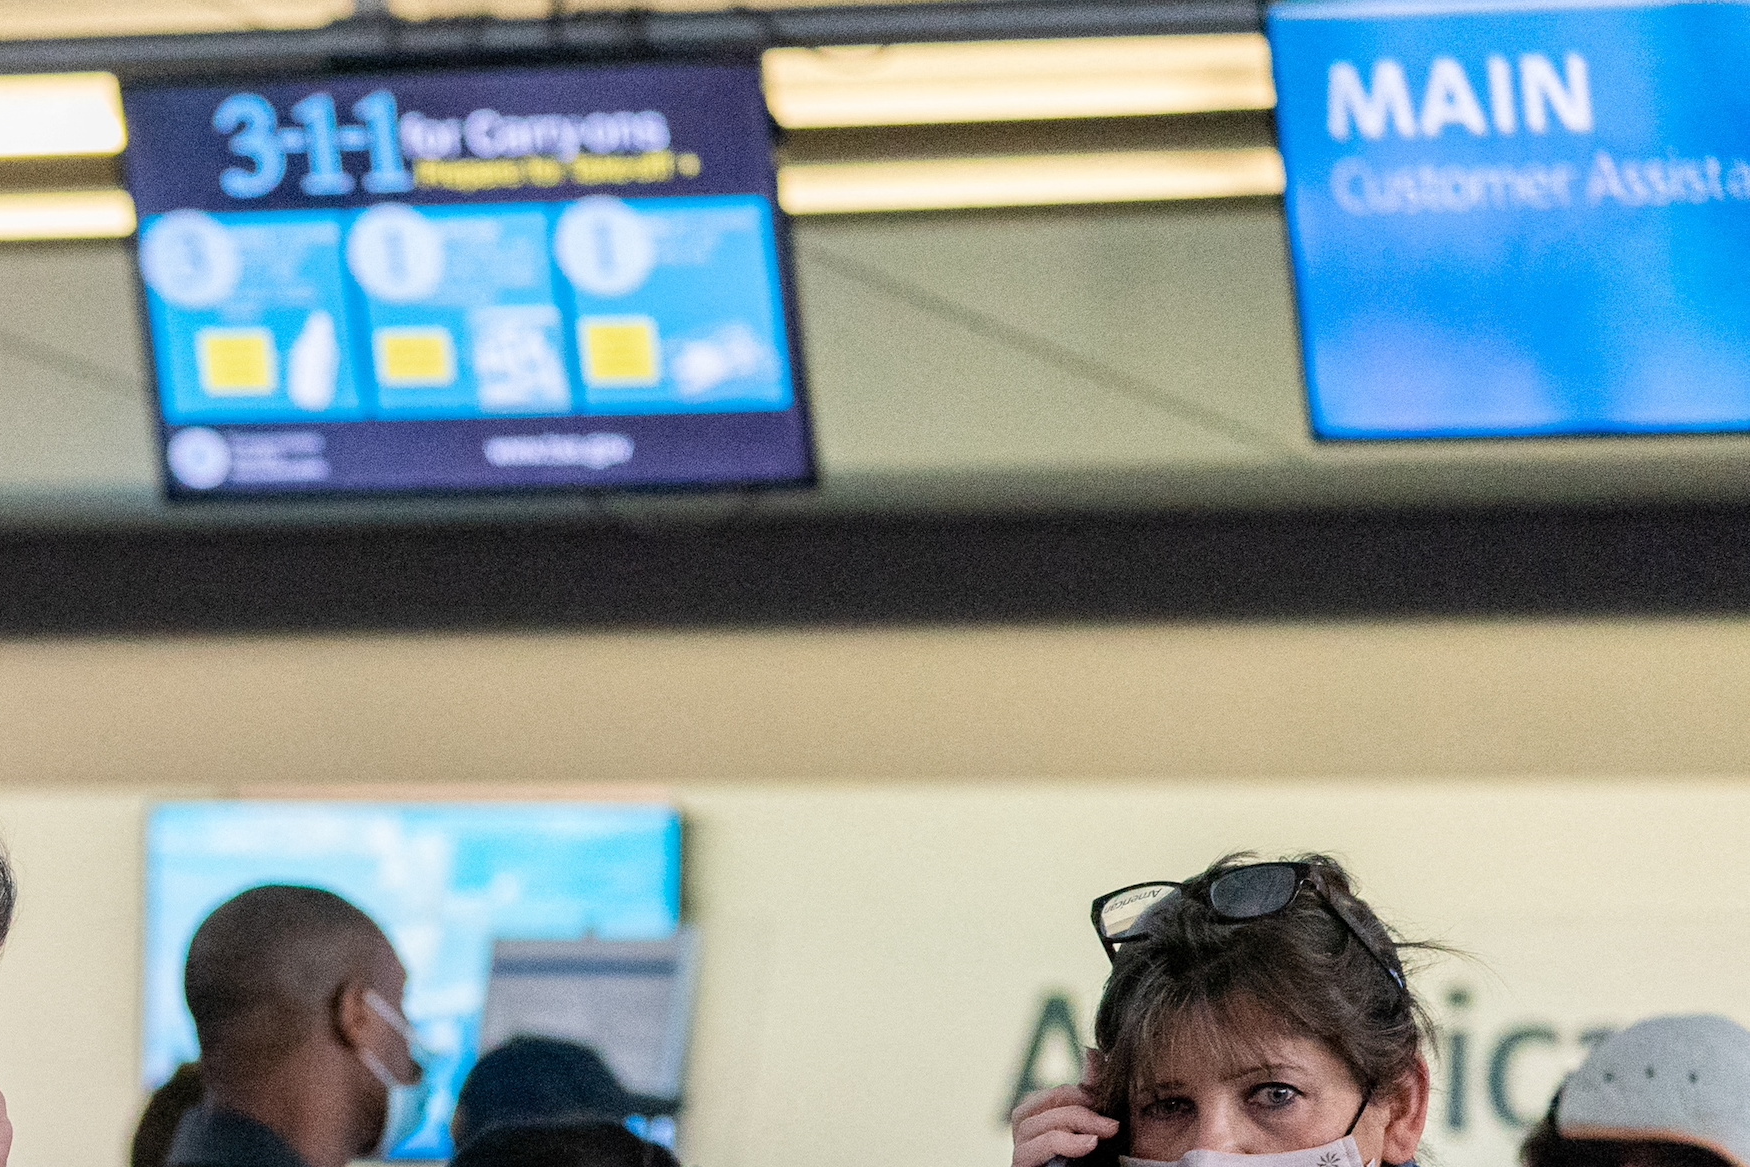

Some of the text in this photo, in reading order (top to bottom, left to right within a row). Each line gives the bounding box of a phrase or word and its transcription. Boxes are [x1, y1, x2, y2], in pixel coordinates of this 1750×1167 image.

[1328, 53, 1593, 141] MAIN
[213, 90, 415, 199] 3-1-1
[1331, 155, 1576, 215] Customer
